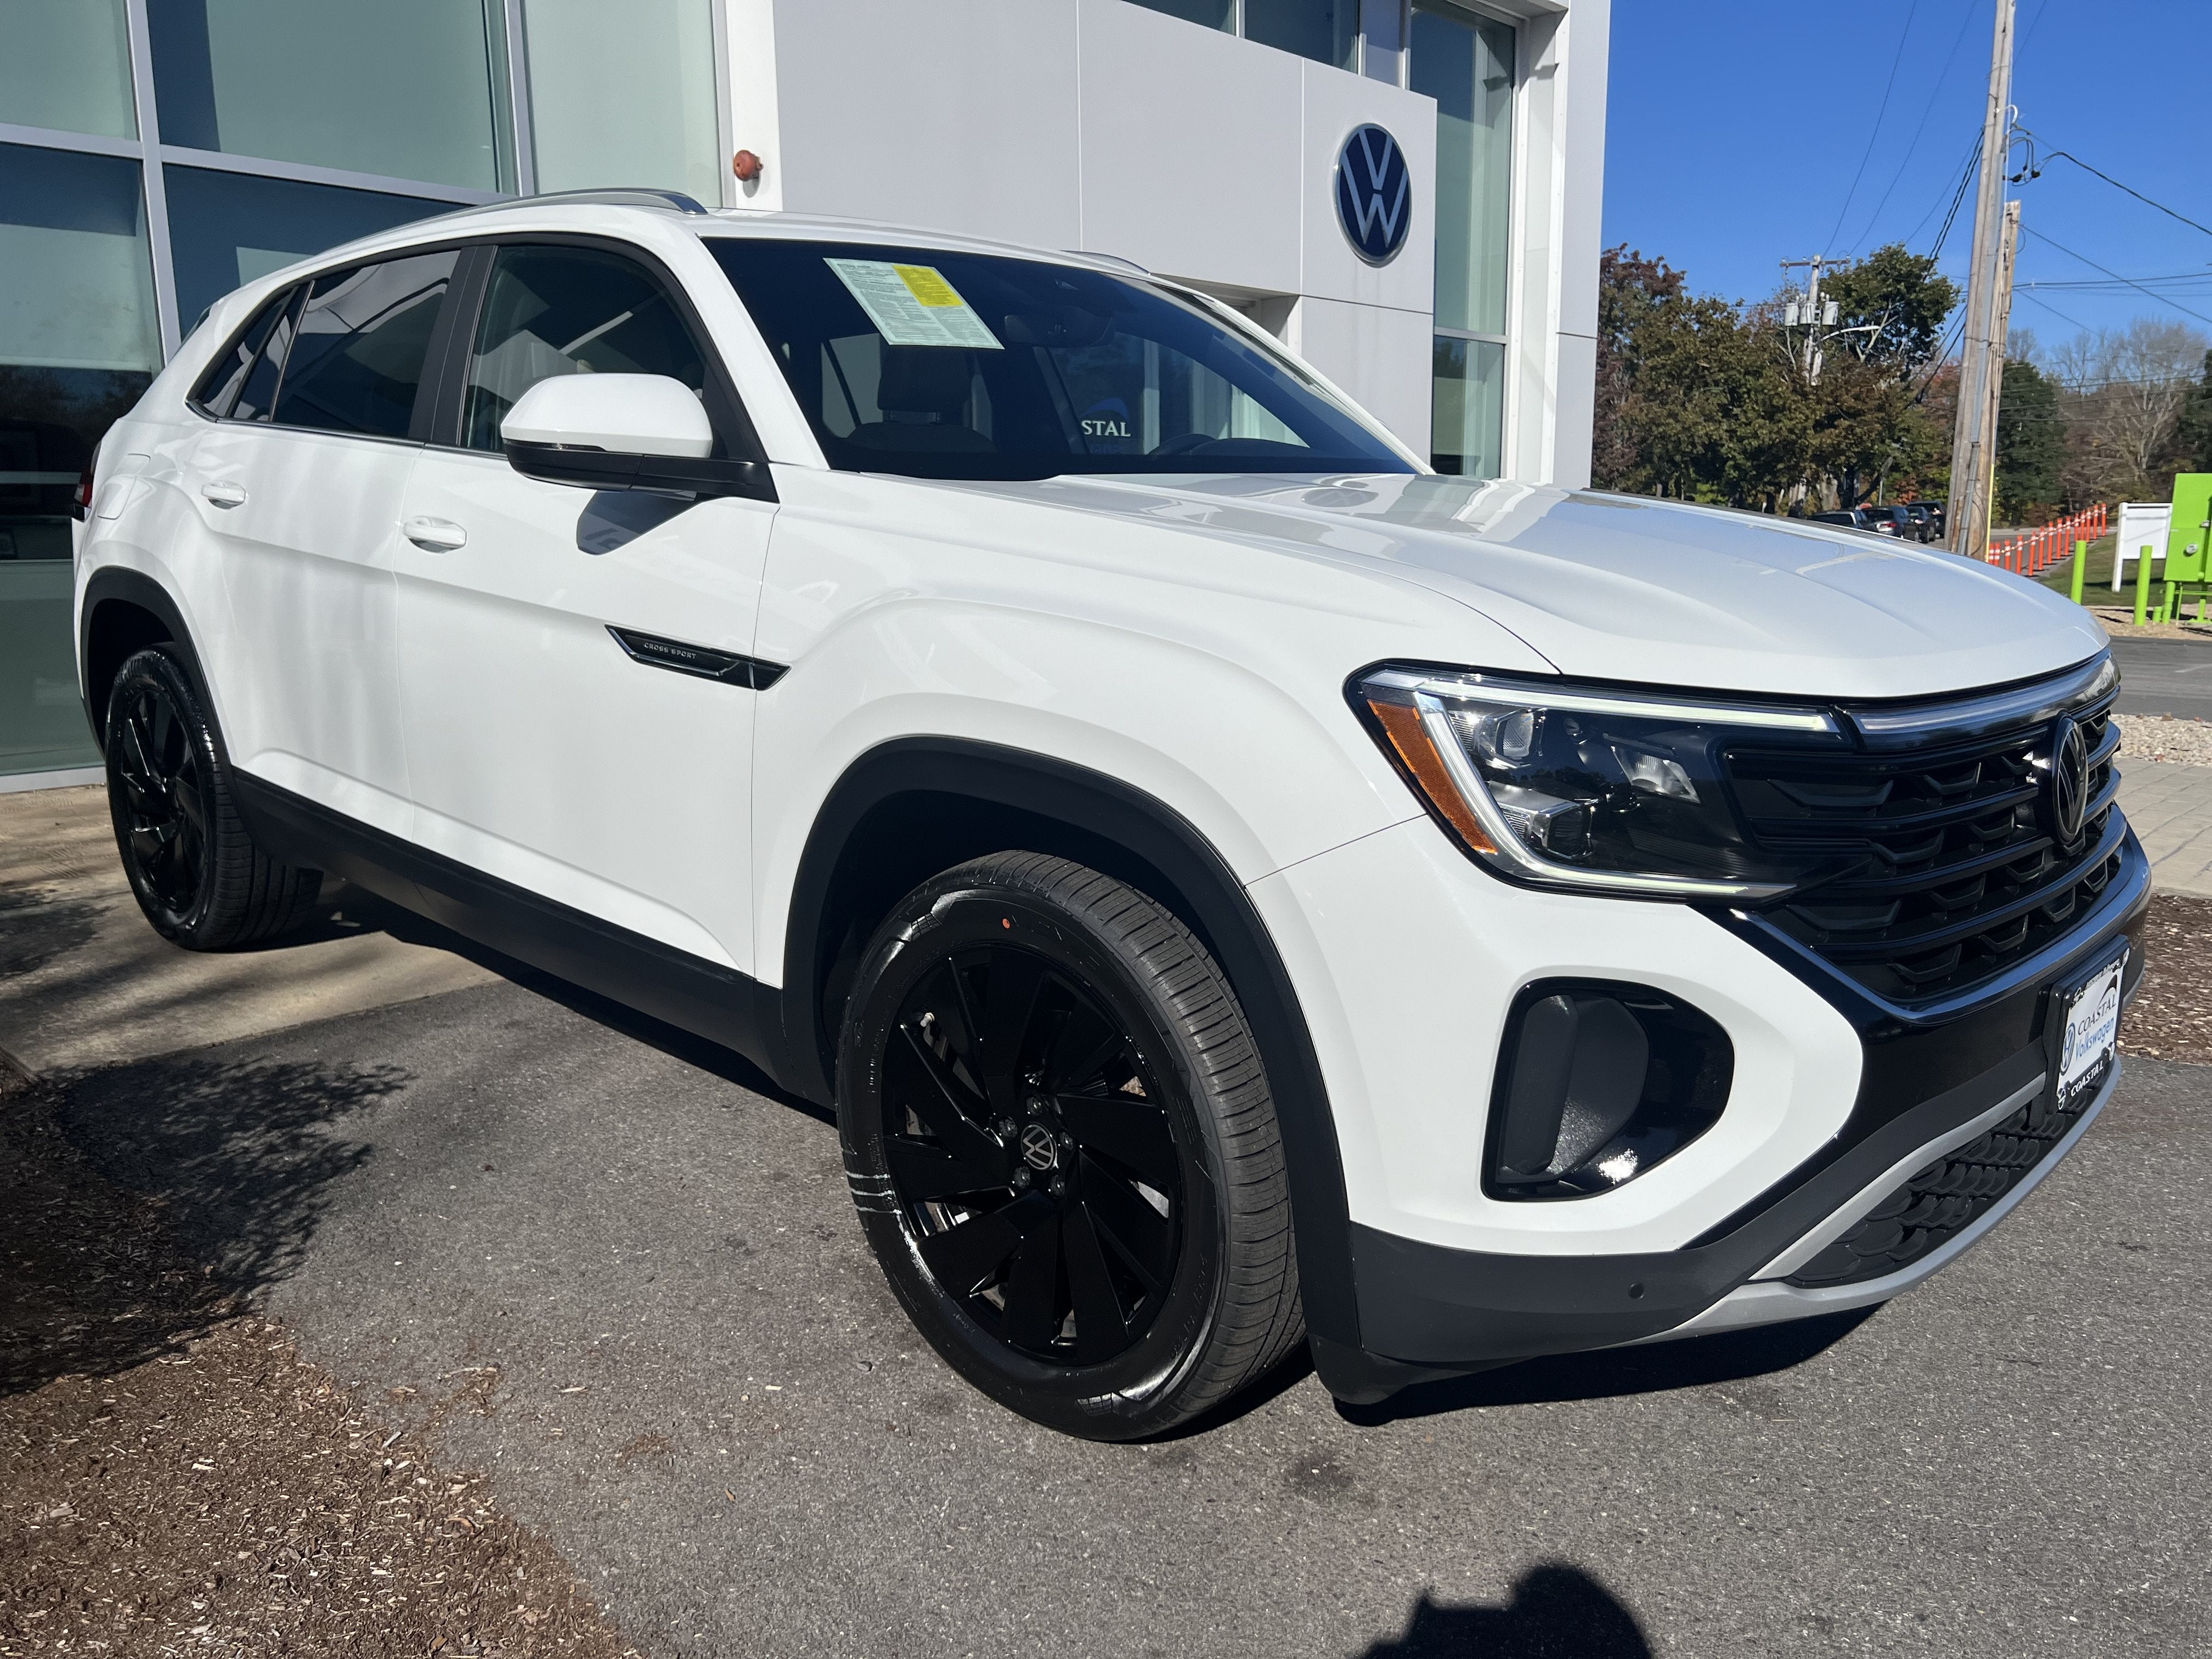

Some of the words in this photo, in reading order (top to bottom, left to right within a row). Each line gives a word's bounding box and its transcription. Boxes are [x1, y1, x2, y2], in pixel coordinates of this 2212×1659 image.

[1339, 127, 1410, 250] VW
[644, 642, 669, 653] CROSS
[671, 647, 697, 659] SPORT
[2078, 994, 2117, 1036] COASTAL
[2075, 1017, 2114, 1061] Volkswagen
[2070, 1059, 2104, 1097] COASTAL
[1021, 1124, 1053, 1170] VW
